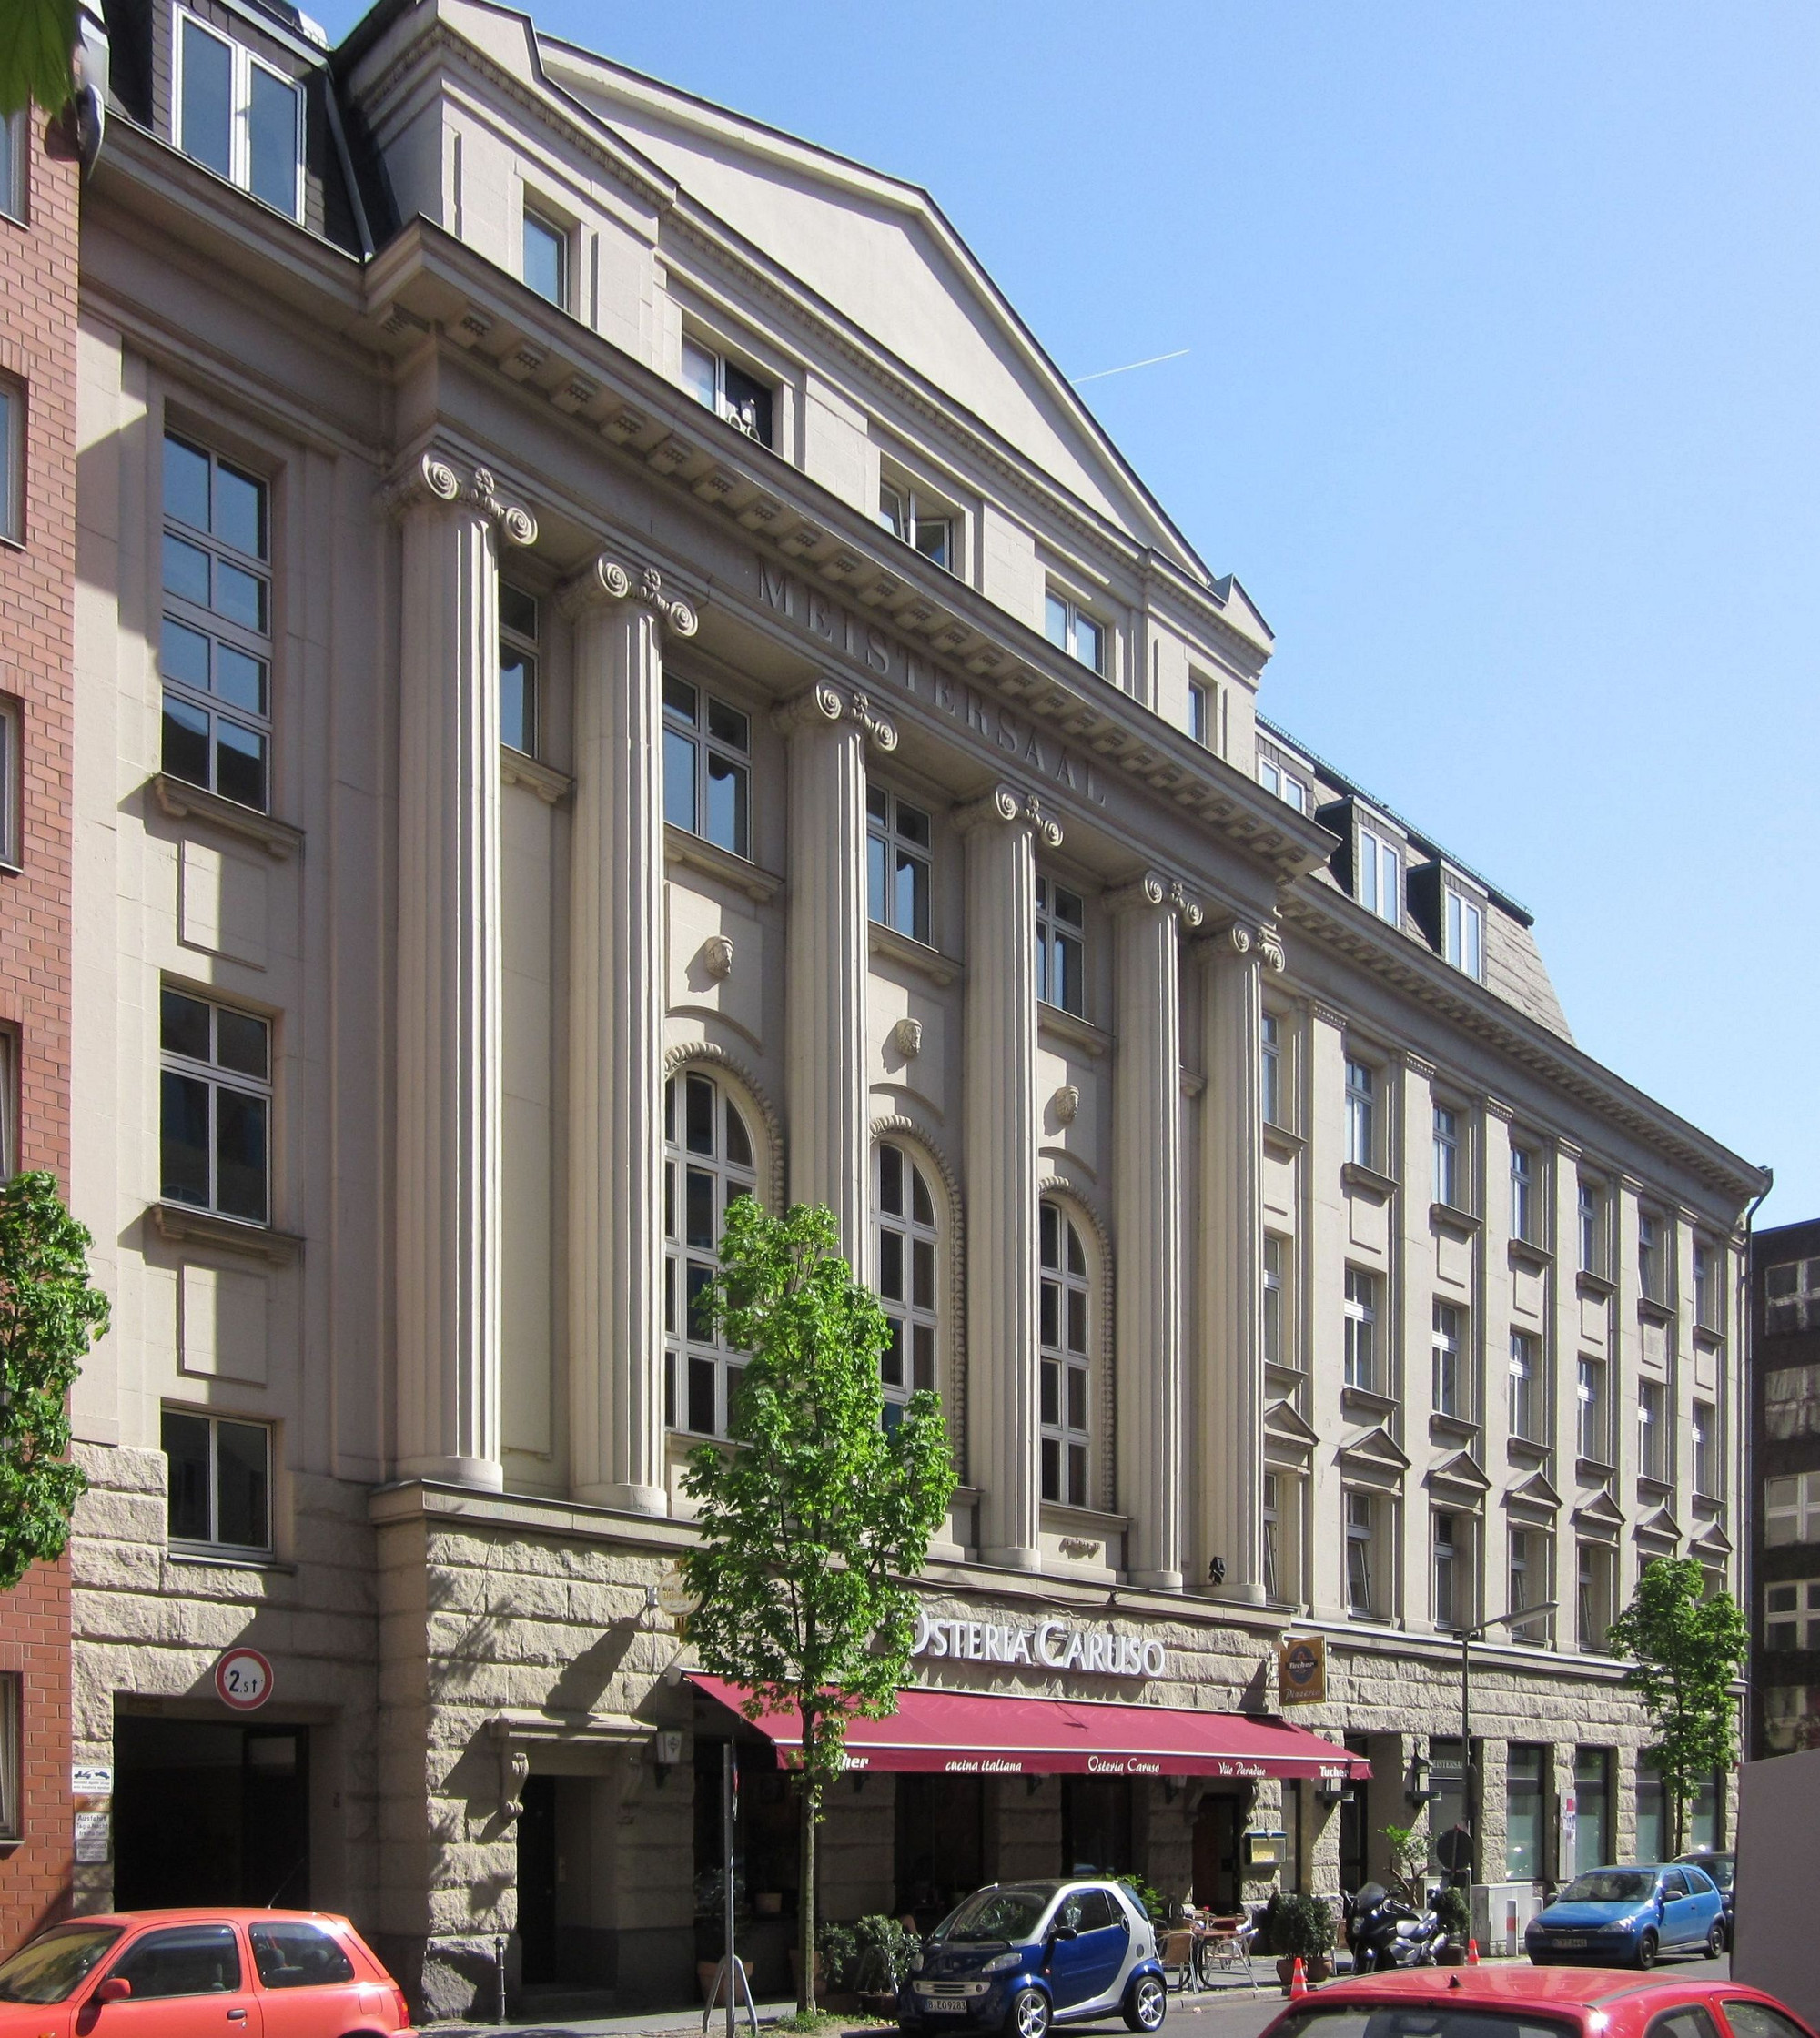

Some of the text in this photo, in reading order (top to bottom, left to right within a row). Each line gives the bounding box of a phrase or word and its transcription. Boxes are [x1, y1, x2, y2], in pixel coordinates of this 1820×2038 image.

[758, 559, 1107, 807] MEISTERSAAL
[945, 1759, 1023, 1772] cucina italiana
[1087, 1755, 1160, 1773] Osteria Caruso
[1235, 1761, 1266, 1776] Paradiso
[1320, 1765, 1349, 1778] Tucher
